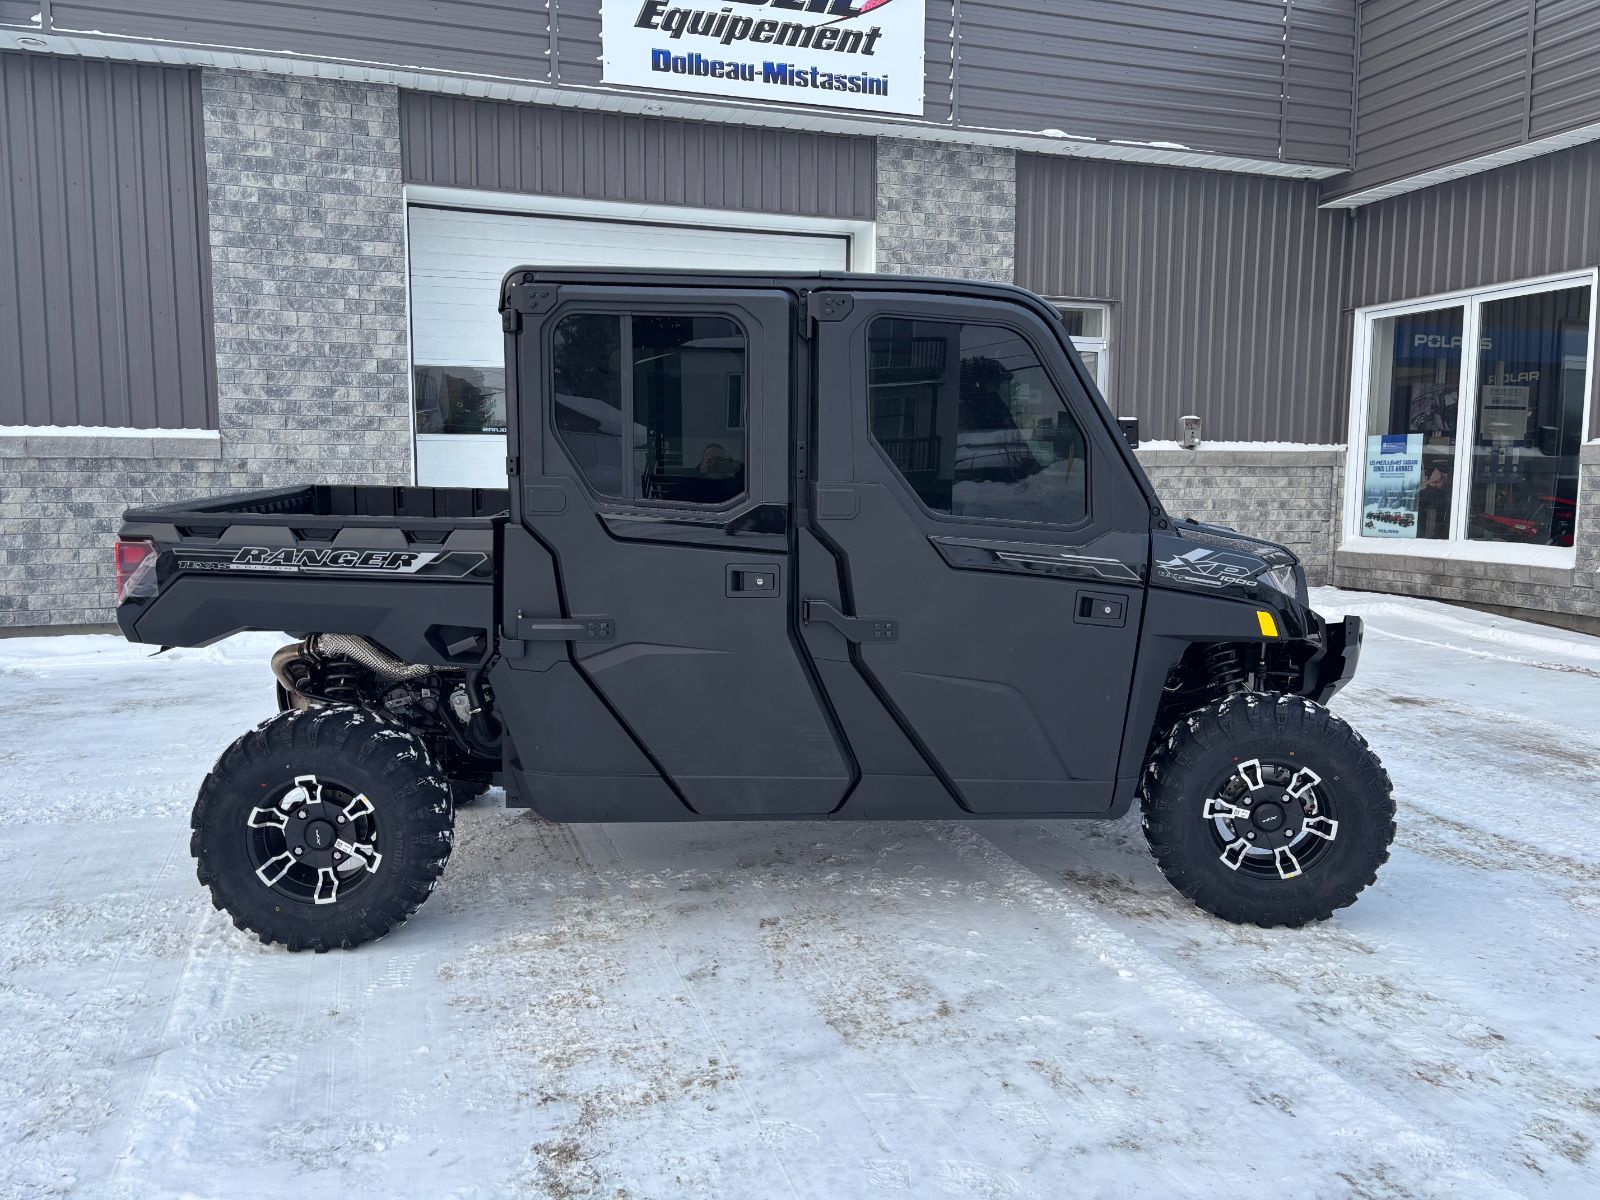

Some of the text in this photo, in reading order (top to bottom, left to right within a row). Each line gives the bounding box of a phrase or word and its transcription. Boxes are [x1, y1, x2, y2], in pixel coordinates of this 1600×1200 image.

[634, 0, 883, 56] Equipement
[651, 48, 889, 96] Dolbeau-Mistassini
[1414, 334, 1493, 350] POLAS
[177, 561, 231, 570] TEXAS
[232, 547, 419, 569] RANGER
[1219, 575, 1258, 587] 1000
